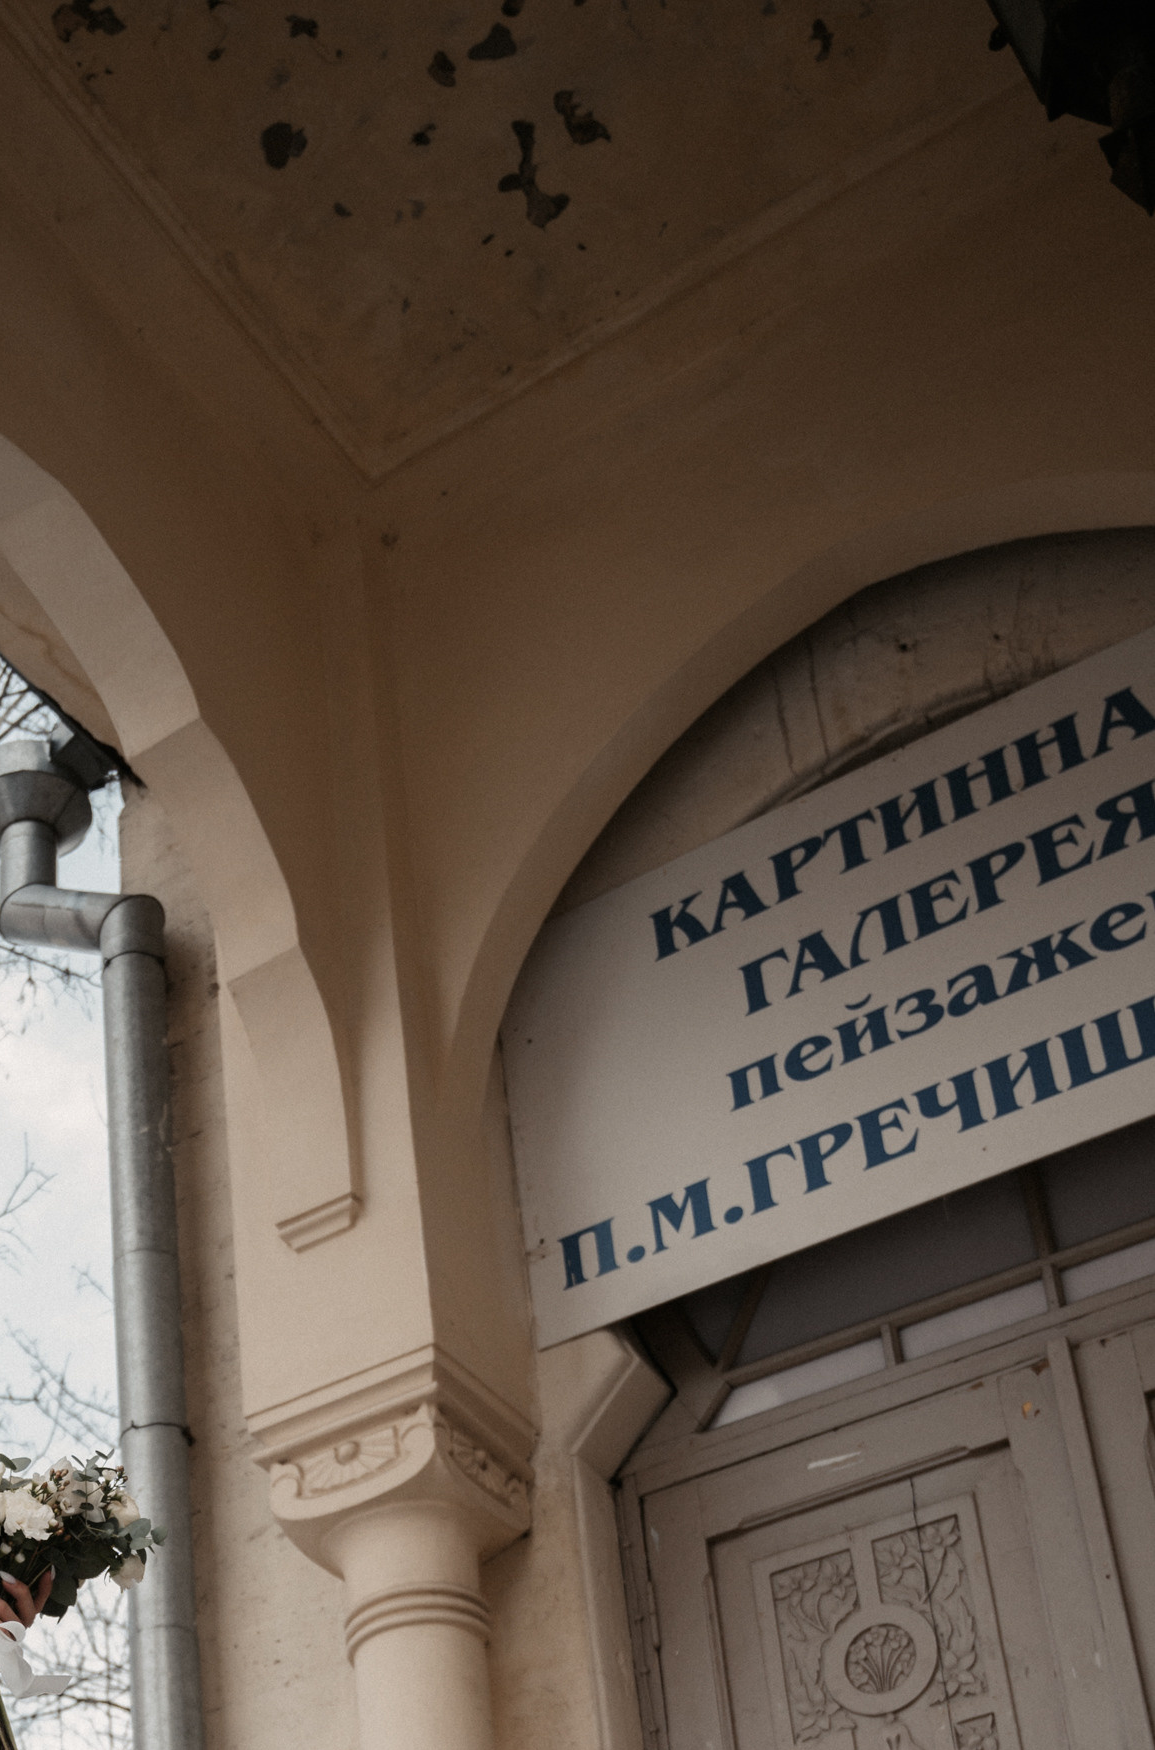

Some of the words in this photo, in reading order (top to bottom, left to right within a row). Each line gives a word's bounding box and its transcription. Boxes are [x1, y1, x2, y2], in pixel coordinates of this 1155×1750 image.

[648, 686, 1155, 962] КАРТИННА
[738, 779, 1155, 1016] ГАЛЕРЕЯ
[726, 890, 1155, 1112] пейзаже
